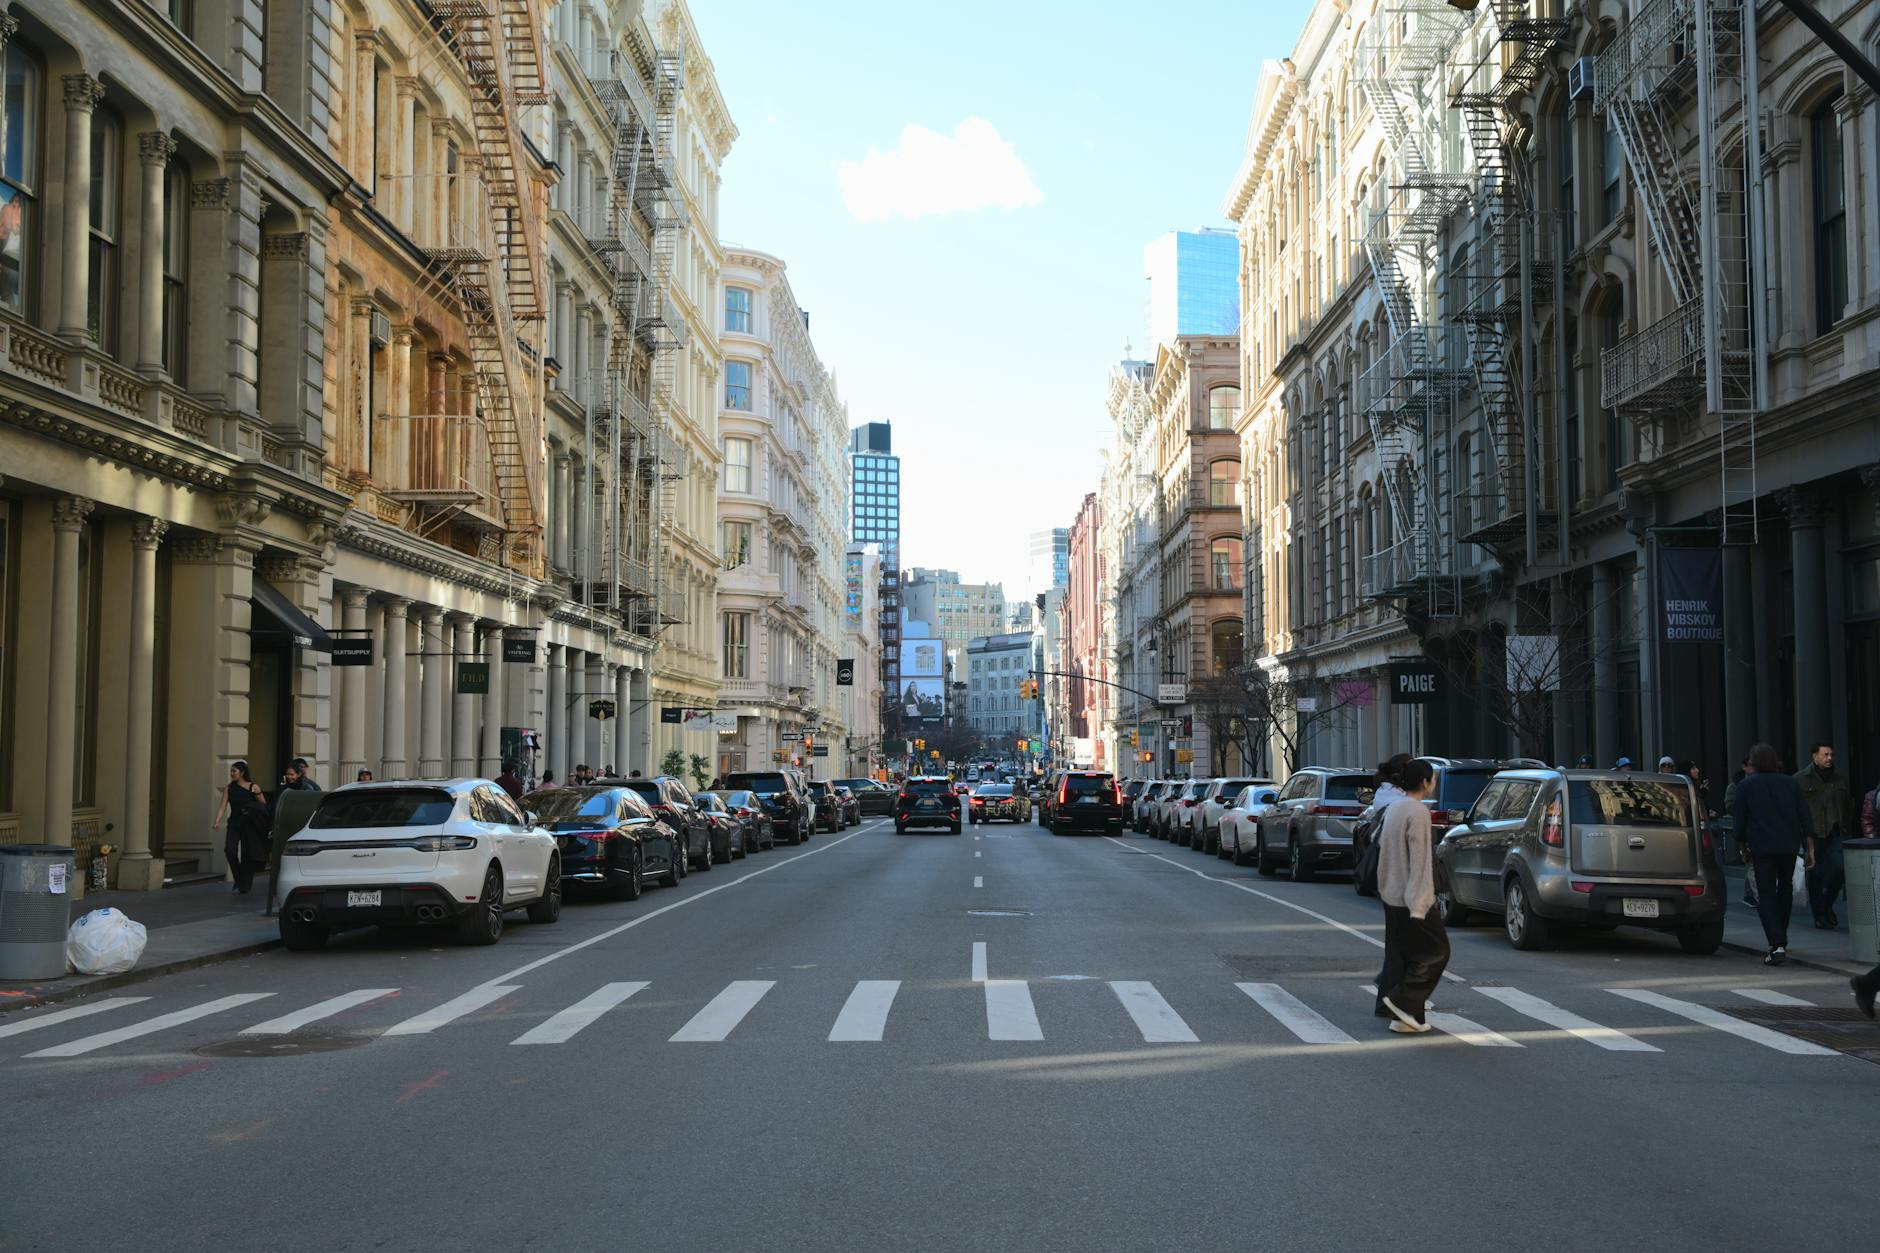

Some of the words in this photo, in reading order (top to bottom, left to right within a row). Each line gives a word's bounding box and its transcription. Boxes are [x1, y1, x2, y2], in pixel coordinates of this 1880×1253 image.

[1666, 600, 1708, 611] HENRIK
[1667, 613, 1716, 625] VIBSKOV
[1667, 627, 1723, 640] BOUTIQUE
[1400, 674, 1436, 692] PAIGE
